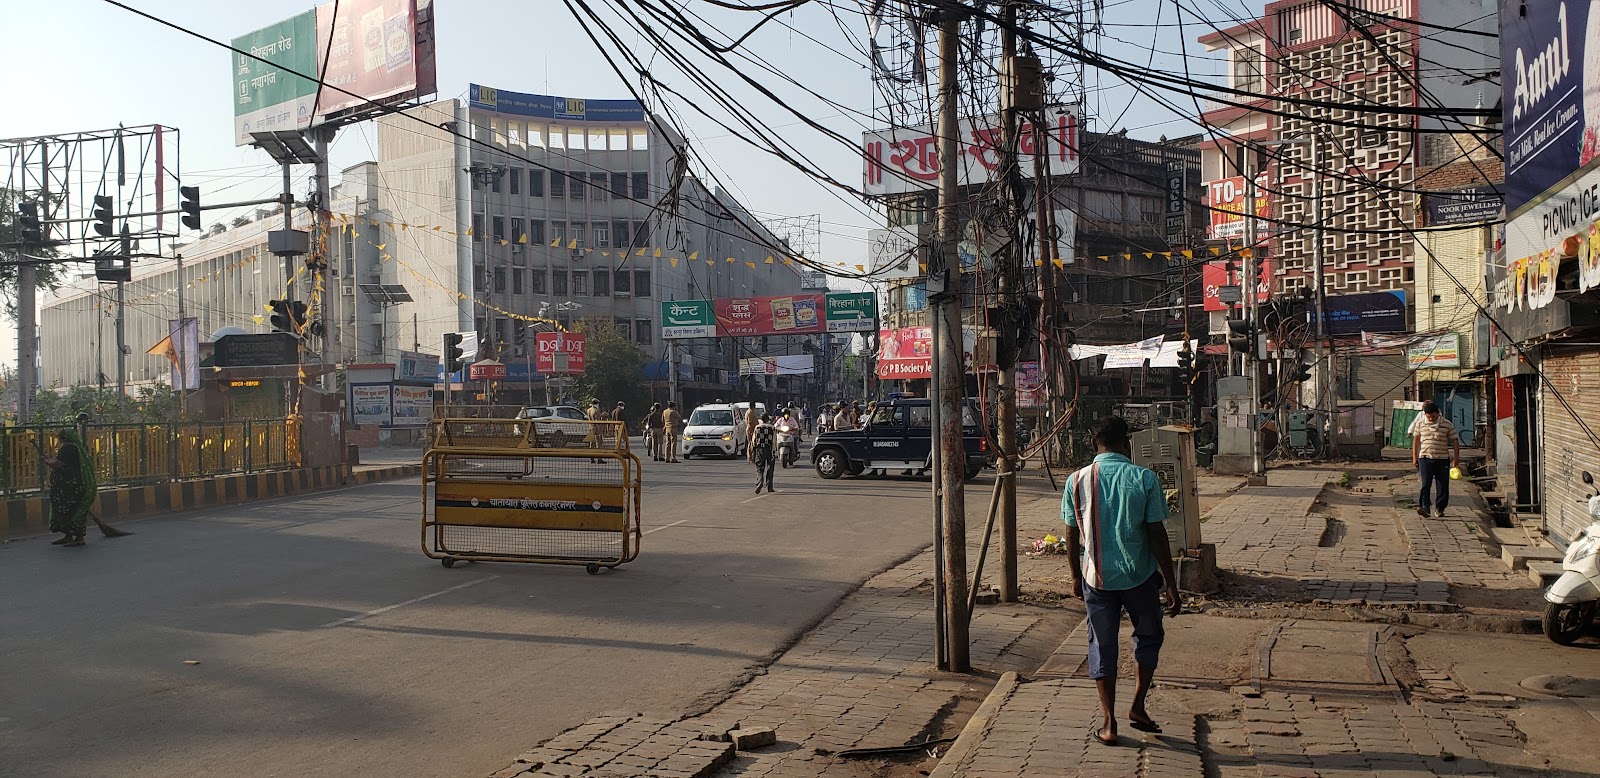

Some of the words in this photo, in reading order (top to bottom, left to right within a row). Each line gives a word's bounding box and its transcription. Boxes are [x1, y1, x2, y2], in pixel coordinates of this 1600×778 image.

[278, 36, 291, 52] रोड
[1513, 1, 1570, 134] Amul
[251, 71, 276, 90] नयागंज
[480, 88, 496, 102] LIC
[567, 101, 584, 112] LIC
[1510, 145, 1520, 167] Real
[1534, 122, 1546, 148] Real
[1546, 119, 1554, 137] Ice
[1556, 103, 1578, 131] Cream.
[1213, 175, 1268, 204] TO-ET
[1438, 206, 1459, 214] NOOR
[1461, 202, 1501, 212] JEWELLERS
[1543, 197, 1577, 240] PICNIC
[1579, 184, 1599, 220] ICE
[872, 235, 912, 254] Sona
[670, 303, 698, 316] कैन्ट
[732, 304, 750, 312] शुद्ध
[829, 297, 854, 308] बिरहाना
[900, 363, 924, 374] Society
[490, 499, 520, 508] यातायात
[539, 501, 559, 510] कानपुर
[560, 501, 577, 510] नगर
